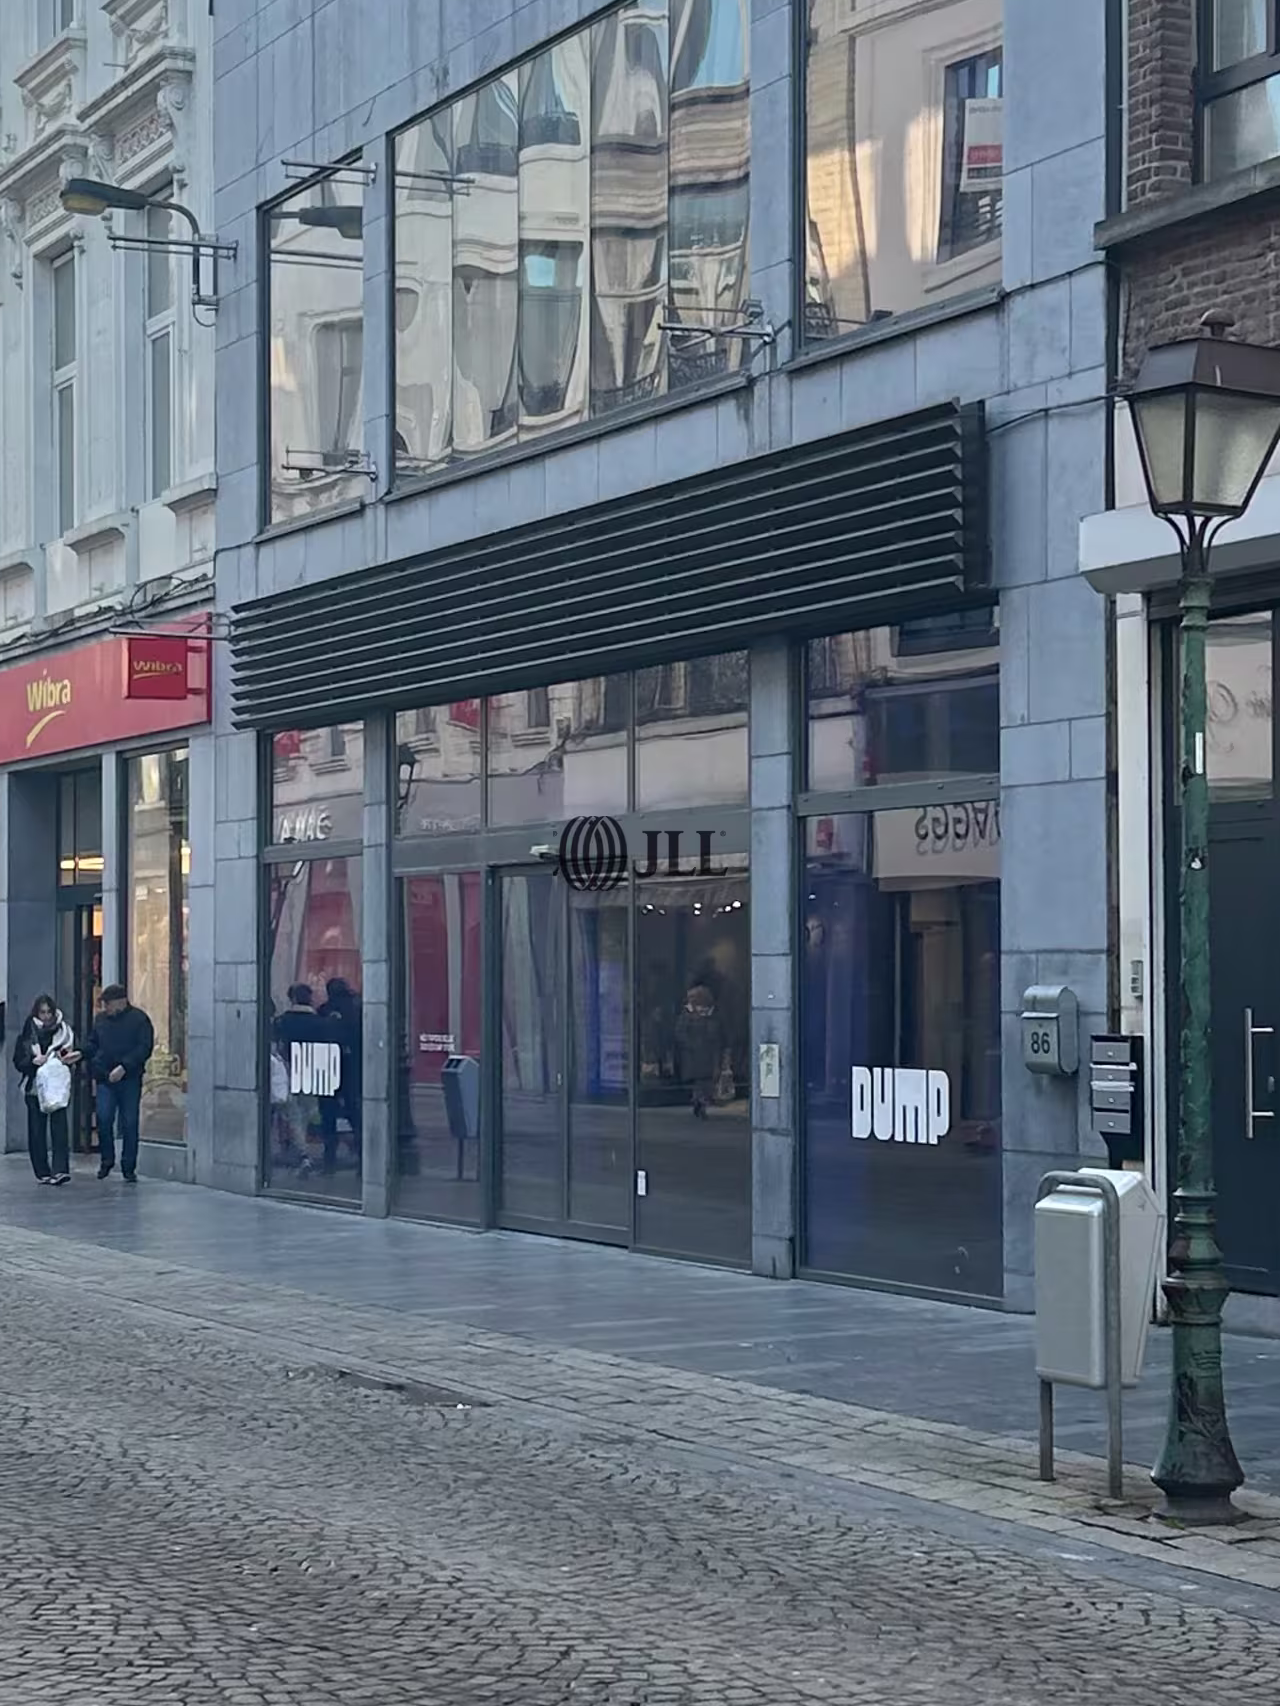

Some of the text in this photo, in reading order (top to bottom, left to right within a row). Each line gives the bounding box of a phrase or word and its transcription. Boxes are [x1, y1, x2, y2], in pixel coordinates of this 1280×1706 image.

[26, 668, 72, 712] Wibra
[1031, 1031, 1051, 1055] 86
[290, 1041, 342, 1097] DUMP
[852, 1066, 950, 1145] DUMP
